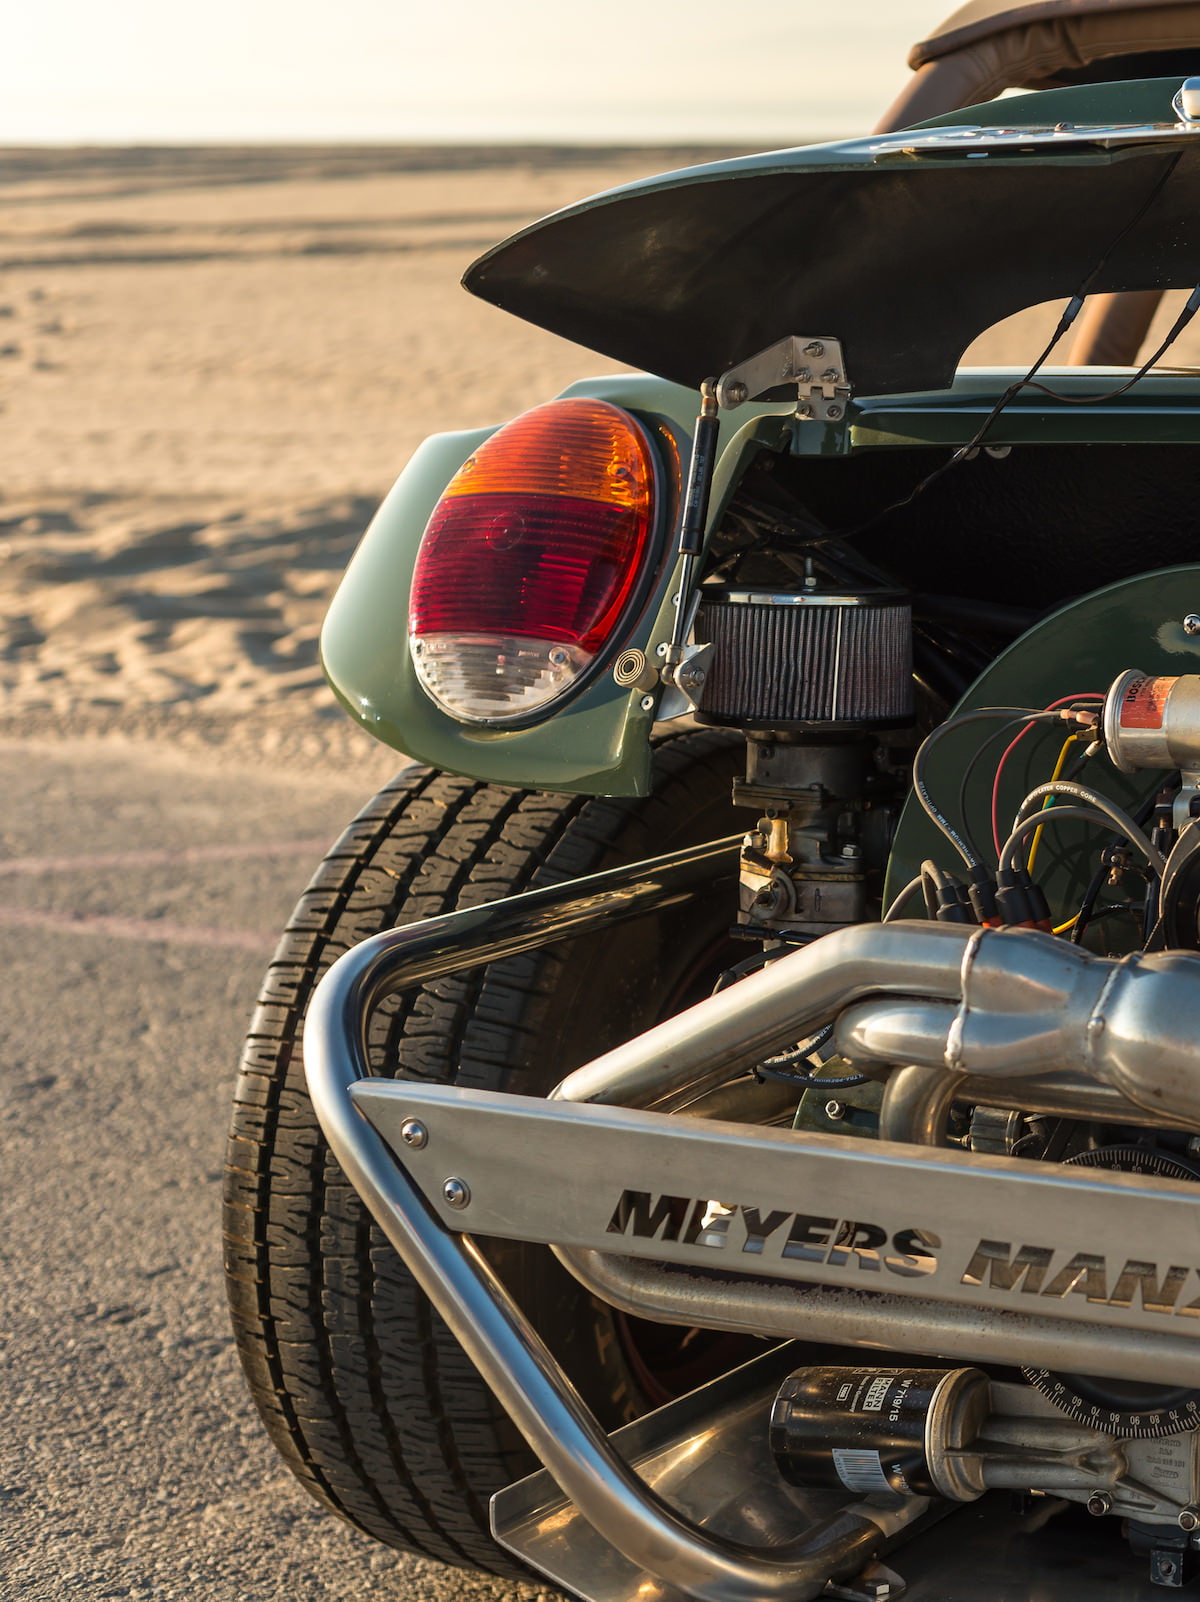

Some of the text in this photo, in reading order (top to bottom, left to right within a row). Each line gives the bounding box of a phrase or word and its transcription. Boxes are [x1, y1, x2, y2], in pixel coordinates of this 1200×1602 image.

[1055, 784, 1078, 794] COPPER
[1080, 791, 1097, 803] CORE
[606, 1189, 942, 1278] MEYERS
[865, 1378, 884, 1408] FILTER
[873, 1378, 892, 1408] MANN
[1054, 1382, 1066, 1394] 50
[889, 1379, 913, 1422] W 719/15
[1071, 1396, 1083, 1408] 60
[1090, 1406, 1101, 1417] 70
[1185, 1401, 1197, 1413] 60
[1109, 1413, 1120, 1424] 80
[1129, 1415, 1140, 1426] 90
[1149, 1414, 1161, 1425] 80
[1168, 1409, 1180, 1420] 70
